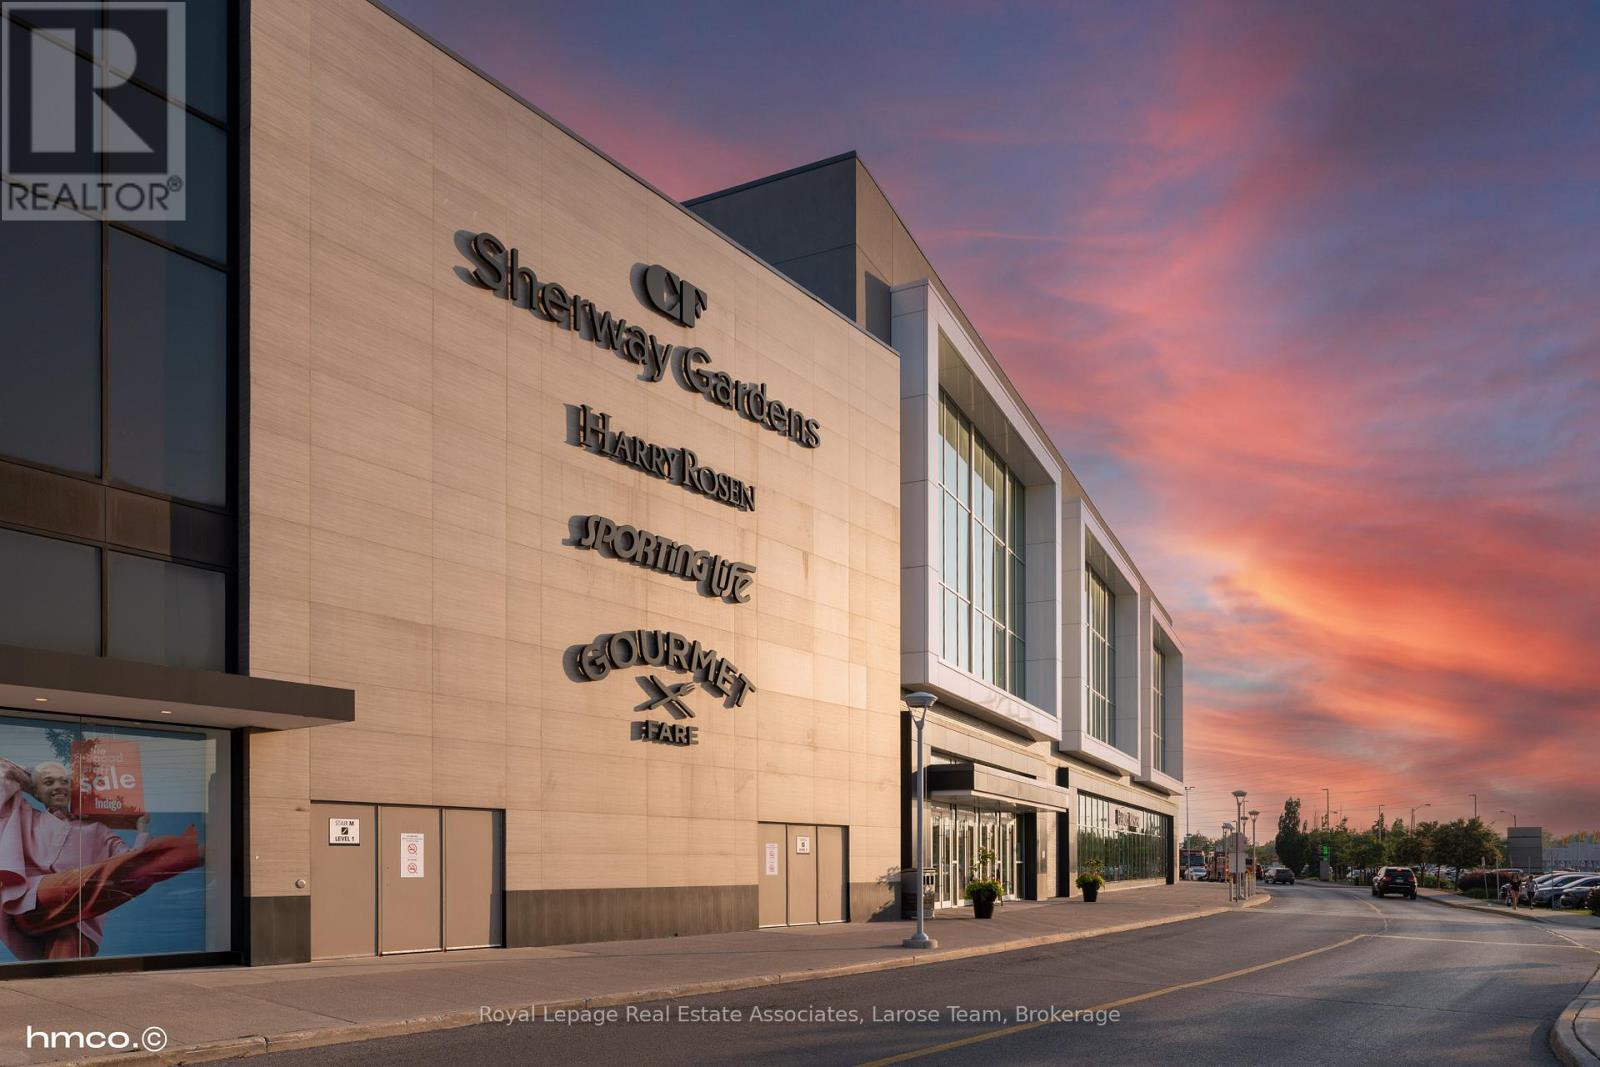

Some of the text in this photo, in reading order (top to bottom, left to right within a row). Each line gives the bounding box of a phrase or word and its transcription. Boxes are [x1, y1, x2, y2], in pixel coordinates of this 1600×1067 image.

[645, 264, 708, 328] CF
[472, 232, 821, 449] Sherway Gardens
[580, 404, 756, 511] HARRY ROSEN
[577, 629, 757, 707] GOURMET
[646, 720, 699, 745] FARE
[80, 766, 136, 793] sale
[95, 797, 122, 811] Indigo
